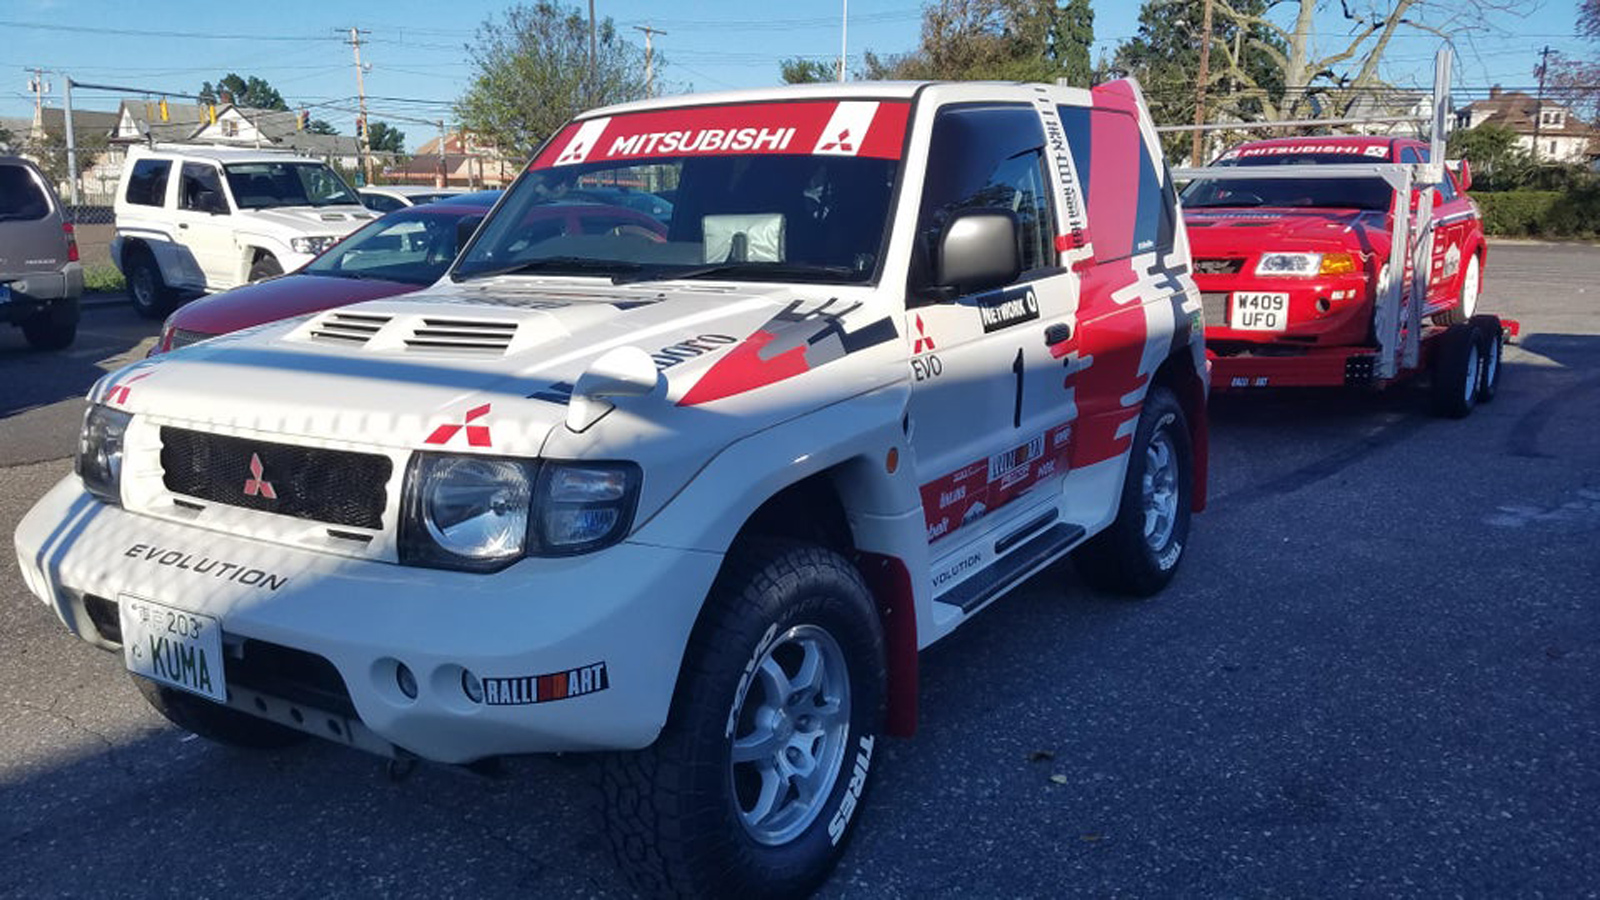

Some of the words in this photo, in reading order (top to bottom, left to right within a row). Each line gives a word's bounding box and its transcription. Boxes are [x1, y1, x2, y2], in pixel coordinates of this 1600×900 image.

[607, 127, 796, 157] MITSUBISHI
[1244, 145, 1359, 157] MITSUBISHI
[1238, 294, 1284, 311] W409
[1242, 312, 1277, 328] UFO
[911, 355, 943, 382] EVO
[1012, 347, 1024, 428] 1
[124, 543, 289, 591] EVOLUTION
[166, 611, 202, 639] 203
[149, 634, 213, 692] KUMA
[827, 734, 875, 847] TIRES
